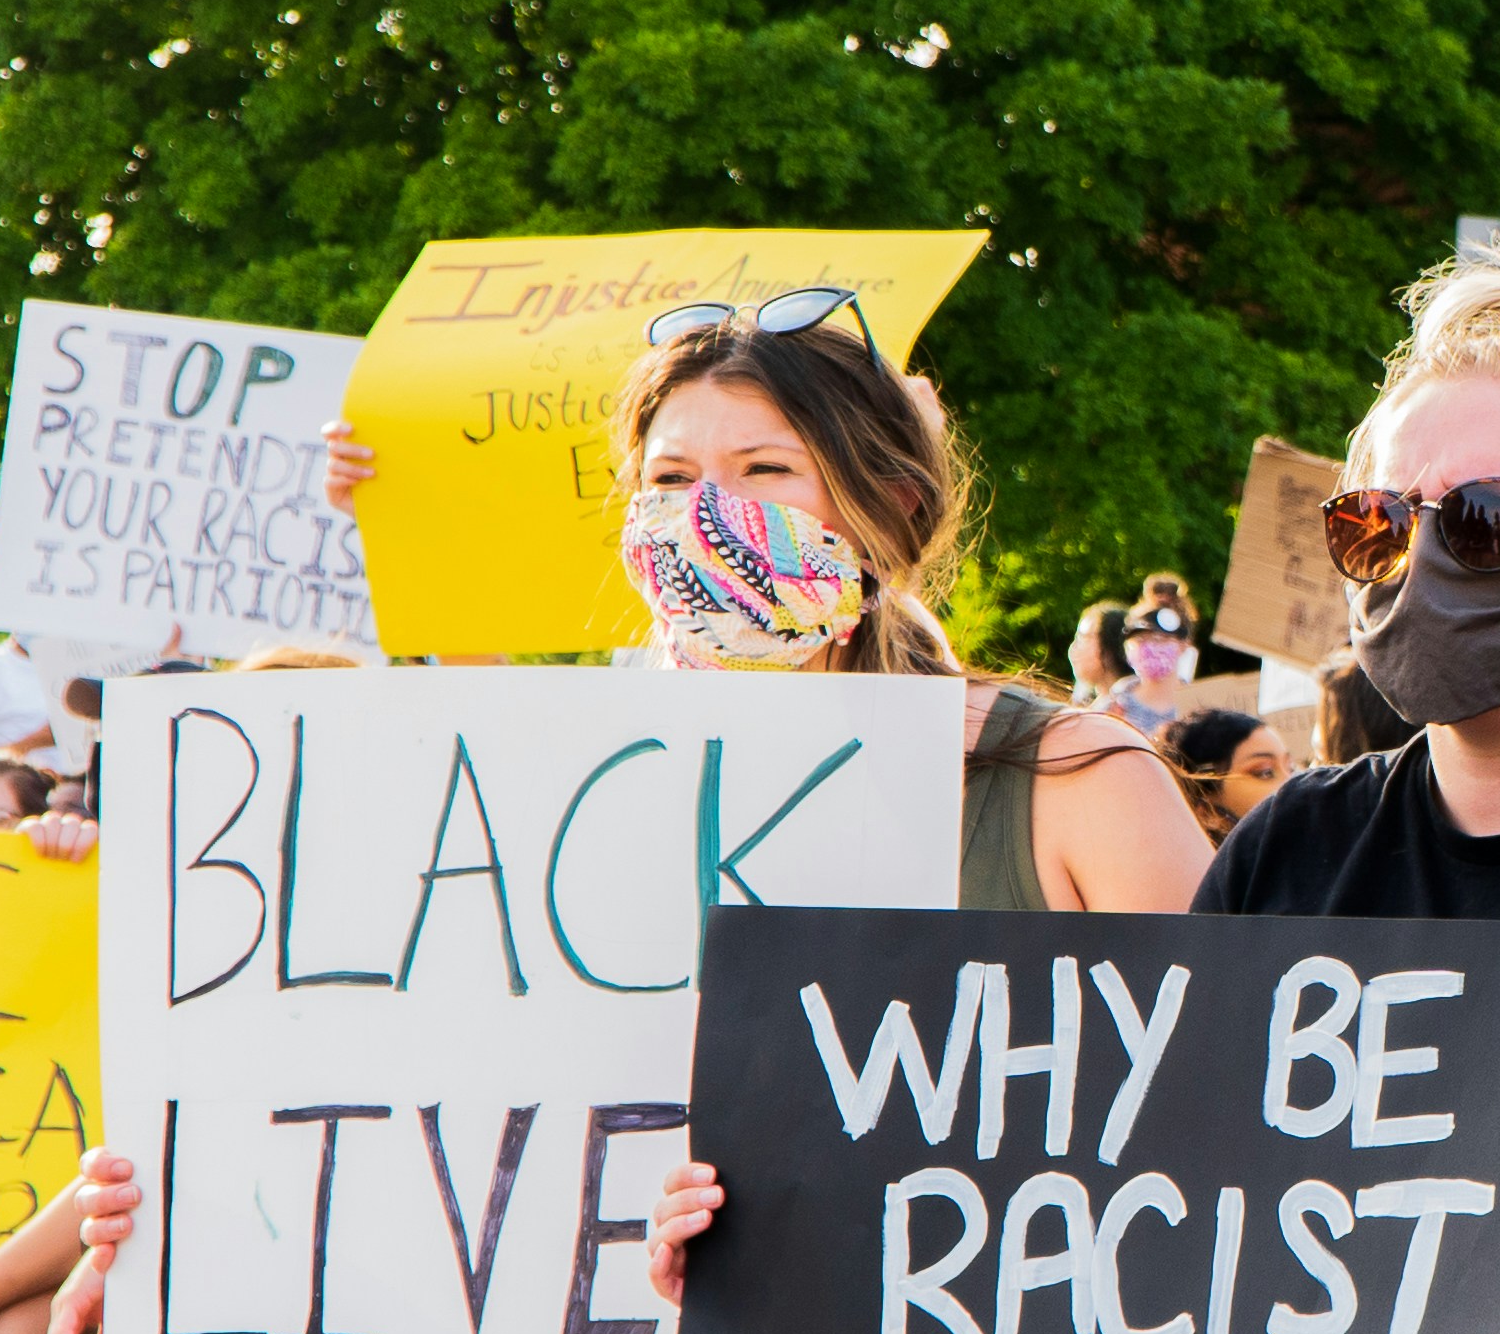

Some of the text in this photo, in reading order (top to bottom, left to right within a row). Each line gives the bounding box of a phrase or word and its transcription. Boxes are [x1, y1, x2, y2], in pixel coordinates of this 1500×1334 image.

[405, 253, 895, 335] Injustice Anyhere
[42, 323, 296, 427] STOP
[32, 402, 326, 510] PRETENDI
[26, 538, 101, 597] IS
[38, 466, 367, 580] YOUR RACIS
[167, 706, 863, 1008] BLACK
[798, 954, 1466, 1166] WHY BE
